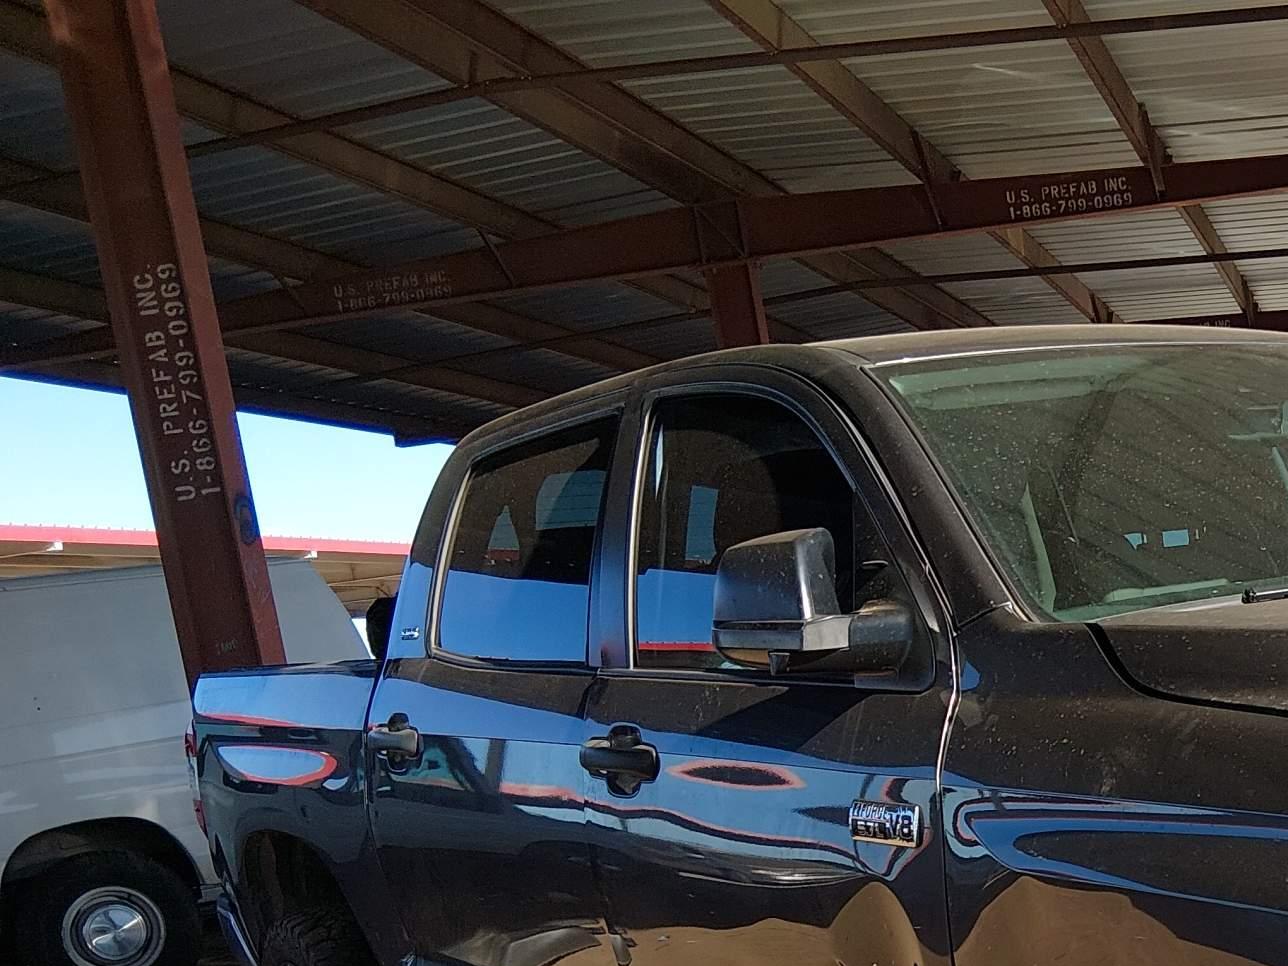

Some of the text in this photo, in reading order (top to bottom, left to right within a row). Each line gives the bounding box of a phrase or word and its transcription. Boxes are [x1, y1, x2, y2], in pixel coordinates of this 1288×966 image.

[1006, 176, 1132, 204] U.S. PREFAB INC.
[1008, 192, 1133, 220] 1-866-799-0969
[133, 263, 197, 501] U.S. PREFAB INC.
[156, 263, 221, 495] 1-866-799-0969
[885, 811, 914, 840] V8
